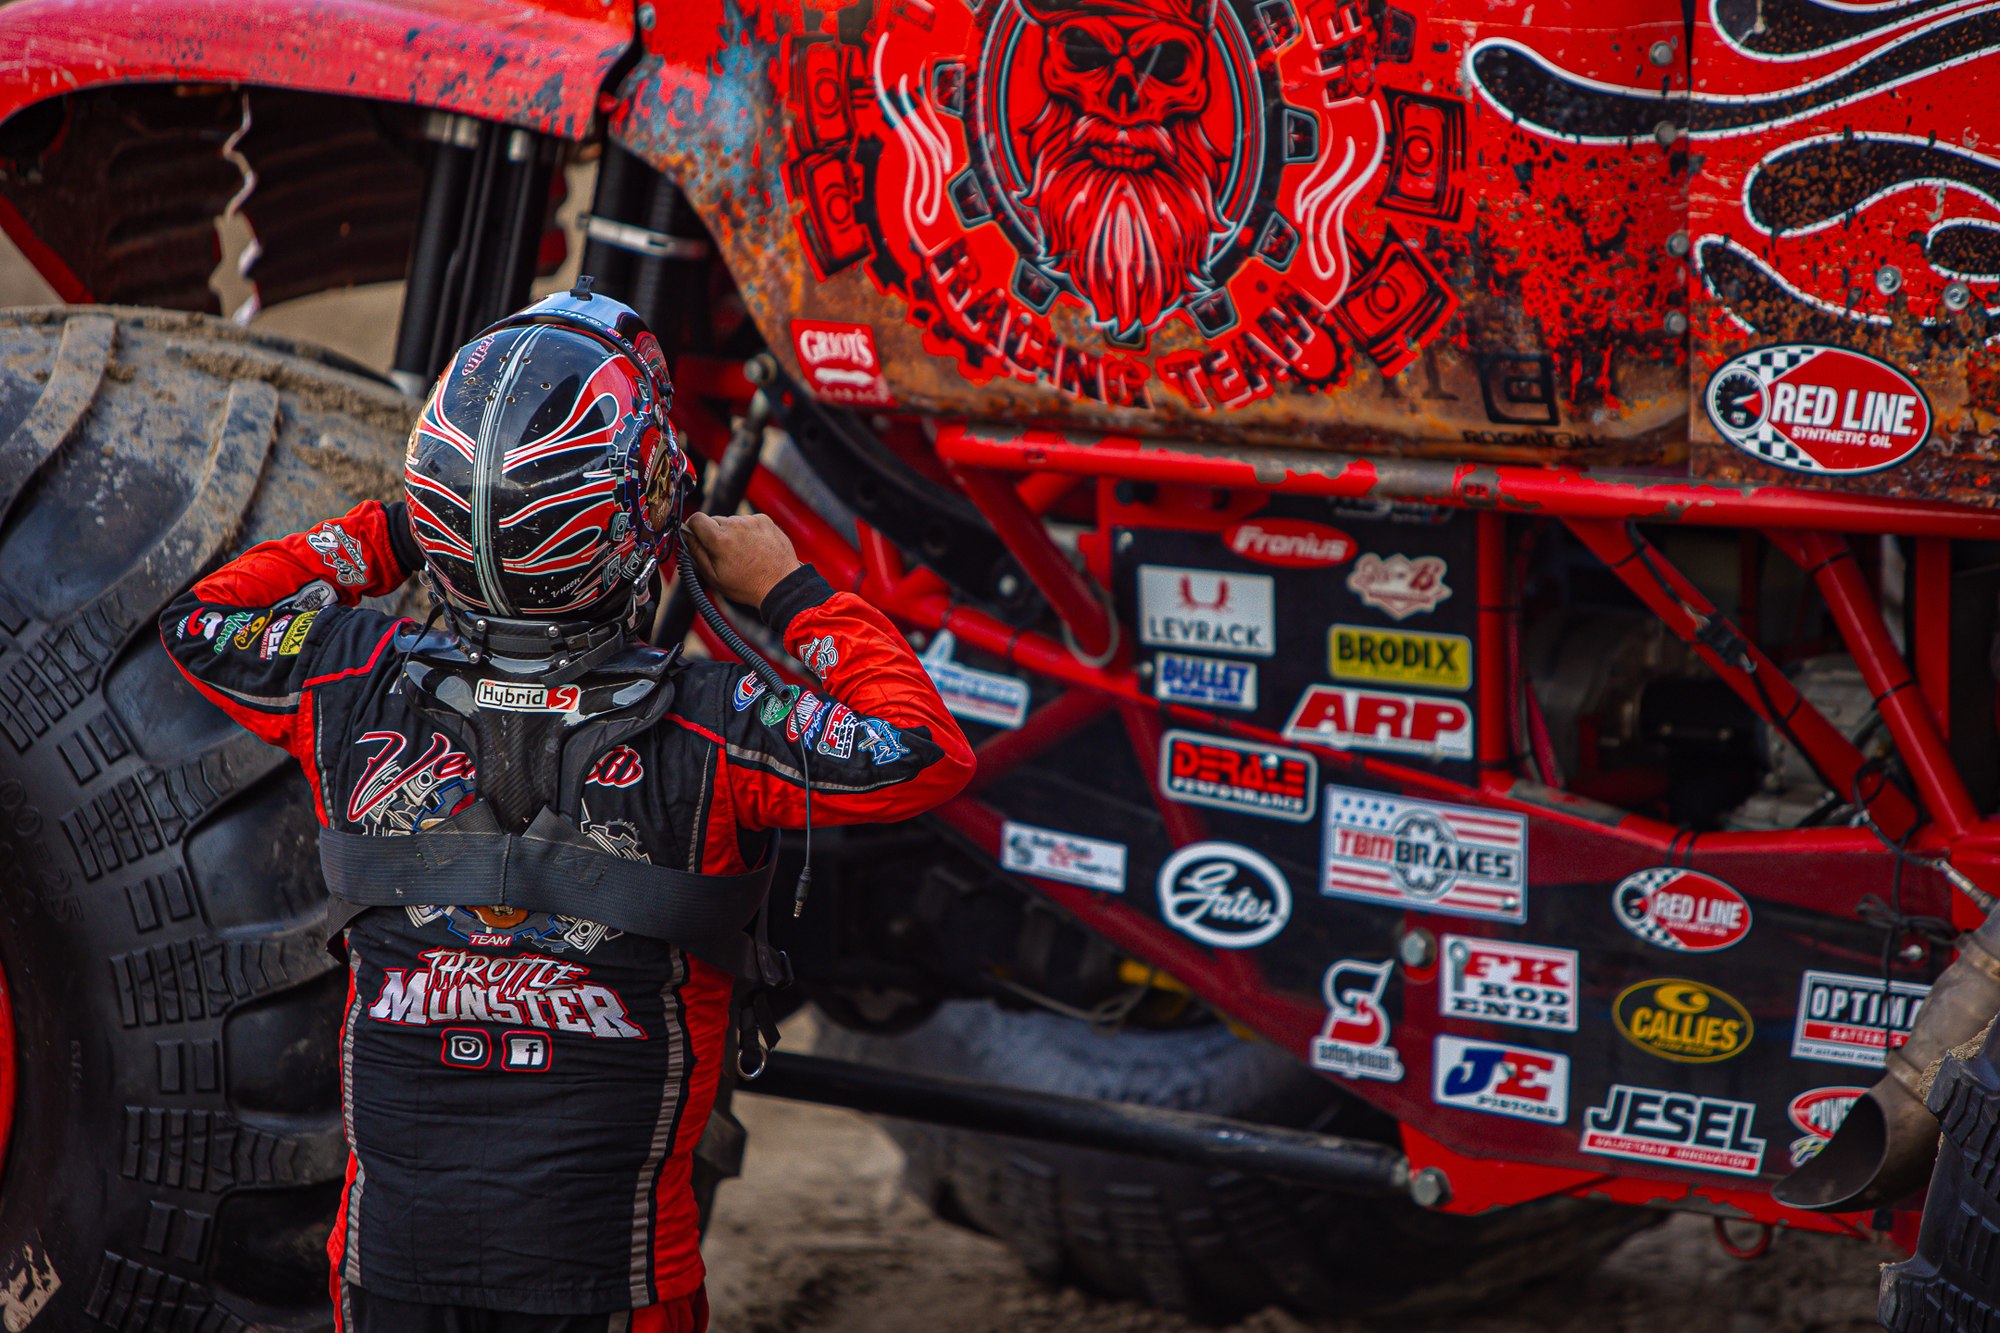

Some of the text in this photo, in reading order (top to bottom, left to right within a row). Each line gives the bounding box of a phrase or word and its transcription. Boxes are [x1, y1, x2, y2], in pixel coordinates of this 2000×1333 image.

[926, 238, 1317, 414] RACING TEAM
[1770, 381, 1917, 436] RED LINE
[1791, 425, 1892, 449] SYNTHETIC OIL
[1232, 525, 1348, 561] Fronius
[213, 612, 254, 655] Norco
[1150, 617, 1262, 649] LEVRACK
[1338, 633, 1459, 672] BRODIX
[482, 685, 545, 706] Hybrid
[1295, 691, 1466, 742] ARP
[1172, 740, 1306, 796] DERALE
[1172, 776, 1304, 812] PERFORMANCE
[1172, 861, 1276, 926] Gates
[1656, 891, 1695, 920] RED
[1696, 896, 1744, 930] LINE
[470, 934, 511, 946] TEAM
[423, 950, 584, 994] THROTTLE
[1464, 951, 1570, 988] FK
[1453, 997, 1568, 1025] ENDS
[1478, 982, 1568, 1006] ROD
[1630, 1006, 1740, 1052] CALLIES
[1444, 1049, 1555, 1101] JE
[1477, 1095, 1559, 1118] PISTONS
[1590, 1088, 1762, 1154] JESEL
